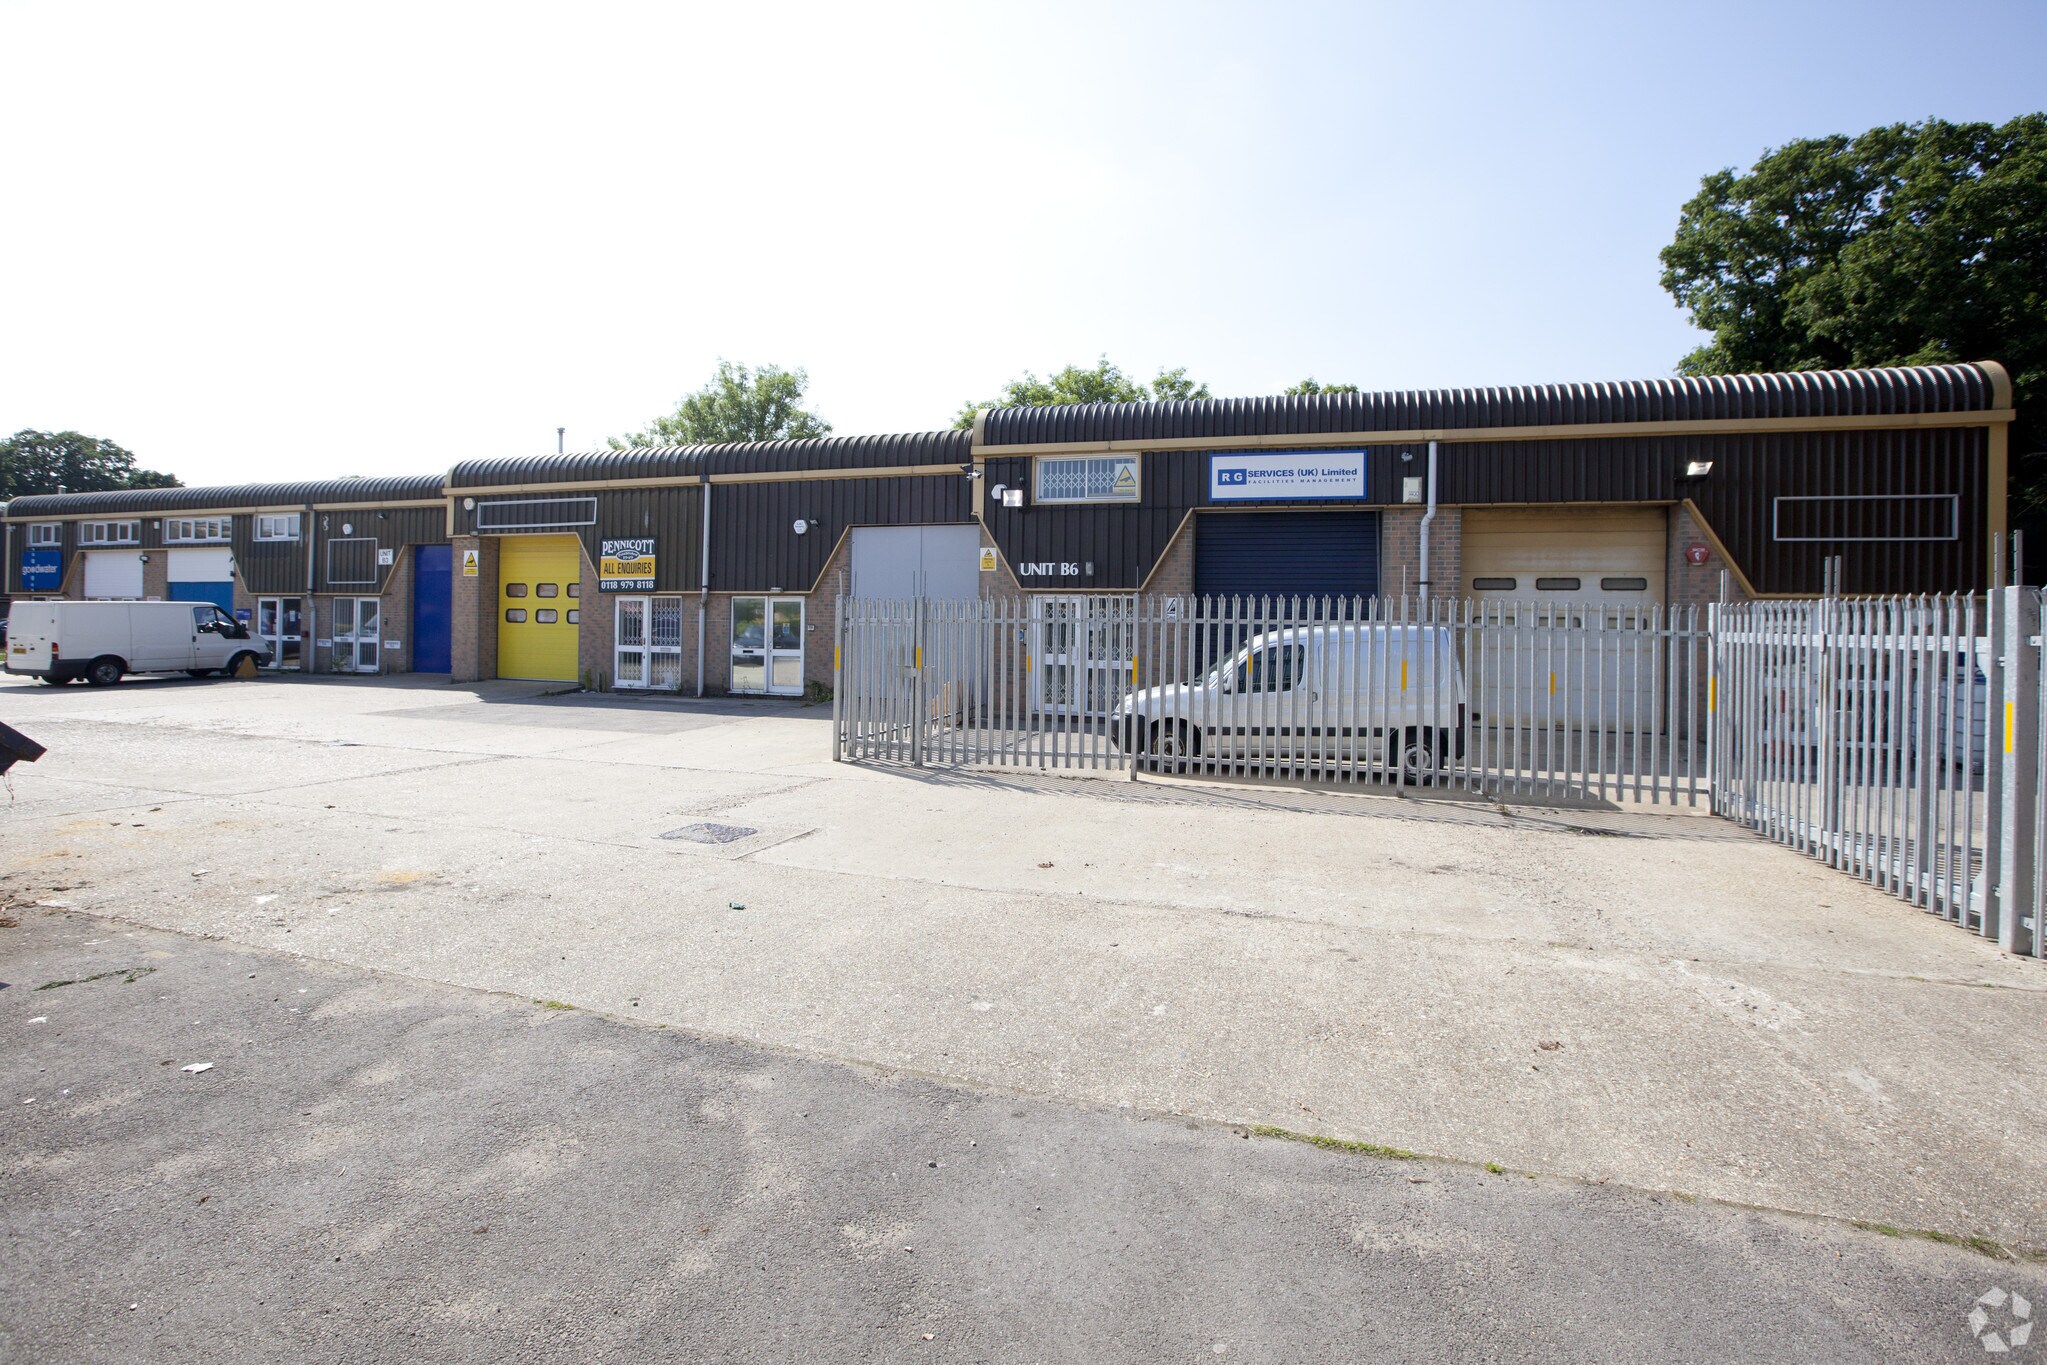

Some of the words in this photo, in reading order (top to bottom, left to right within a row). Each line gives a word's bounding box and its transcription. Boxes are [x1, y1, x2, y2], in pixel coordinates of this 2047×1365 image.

[1222, 473, 1230, 482] R
[1233, 473, 1243, 482] G
[1248, 469, 1294, 478] SERVICES
[1297, 468, 1319, 478] (UK)
[1321, 467, 1357, 476] Limited
[602, 539, 654, 555] PENNICOTT
[604, 562, 615, 574] ALL
[618, 562, 652, 574] ENQUIRIES
[1020, 563, 1055, 576] UNIT
[1060, 562, 1079, 576] B6
[601, 581, 618, 589] 0118
[620, 581, 634, 589] 979
[637, 580, 654, 589] 8118
